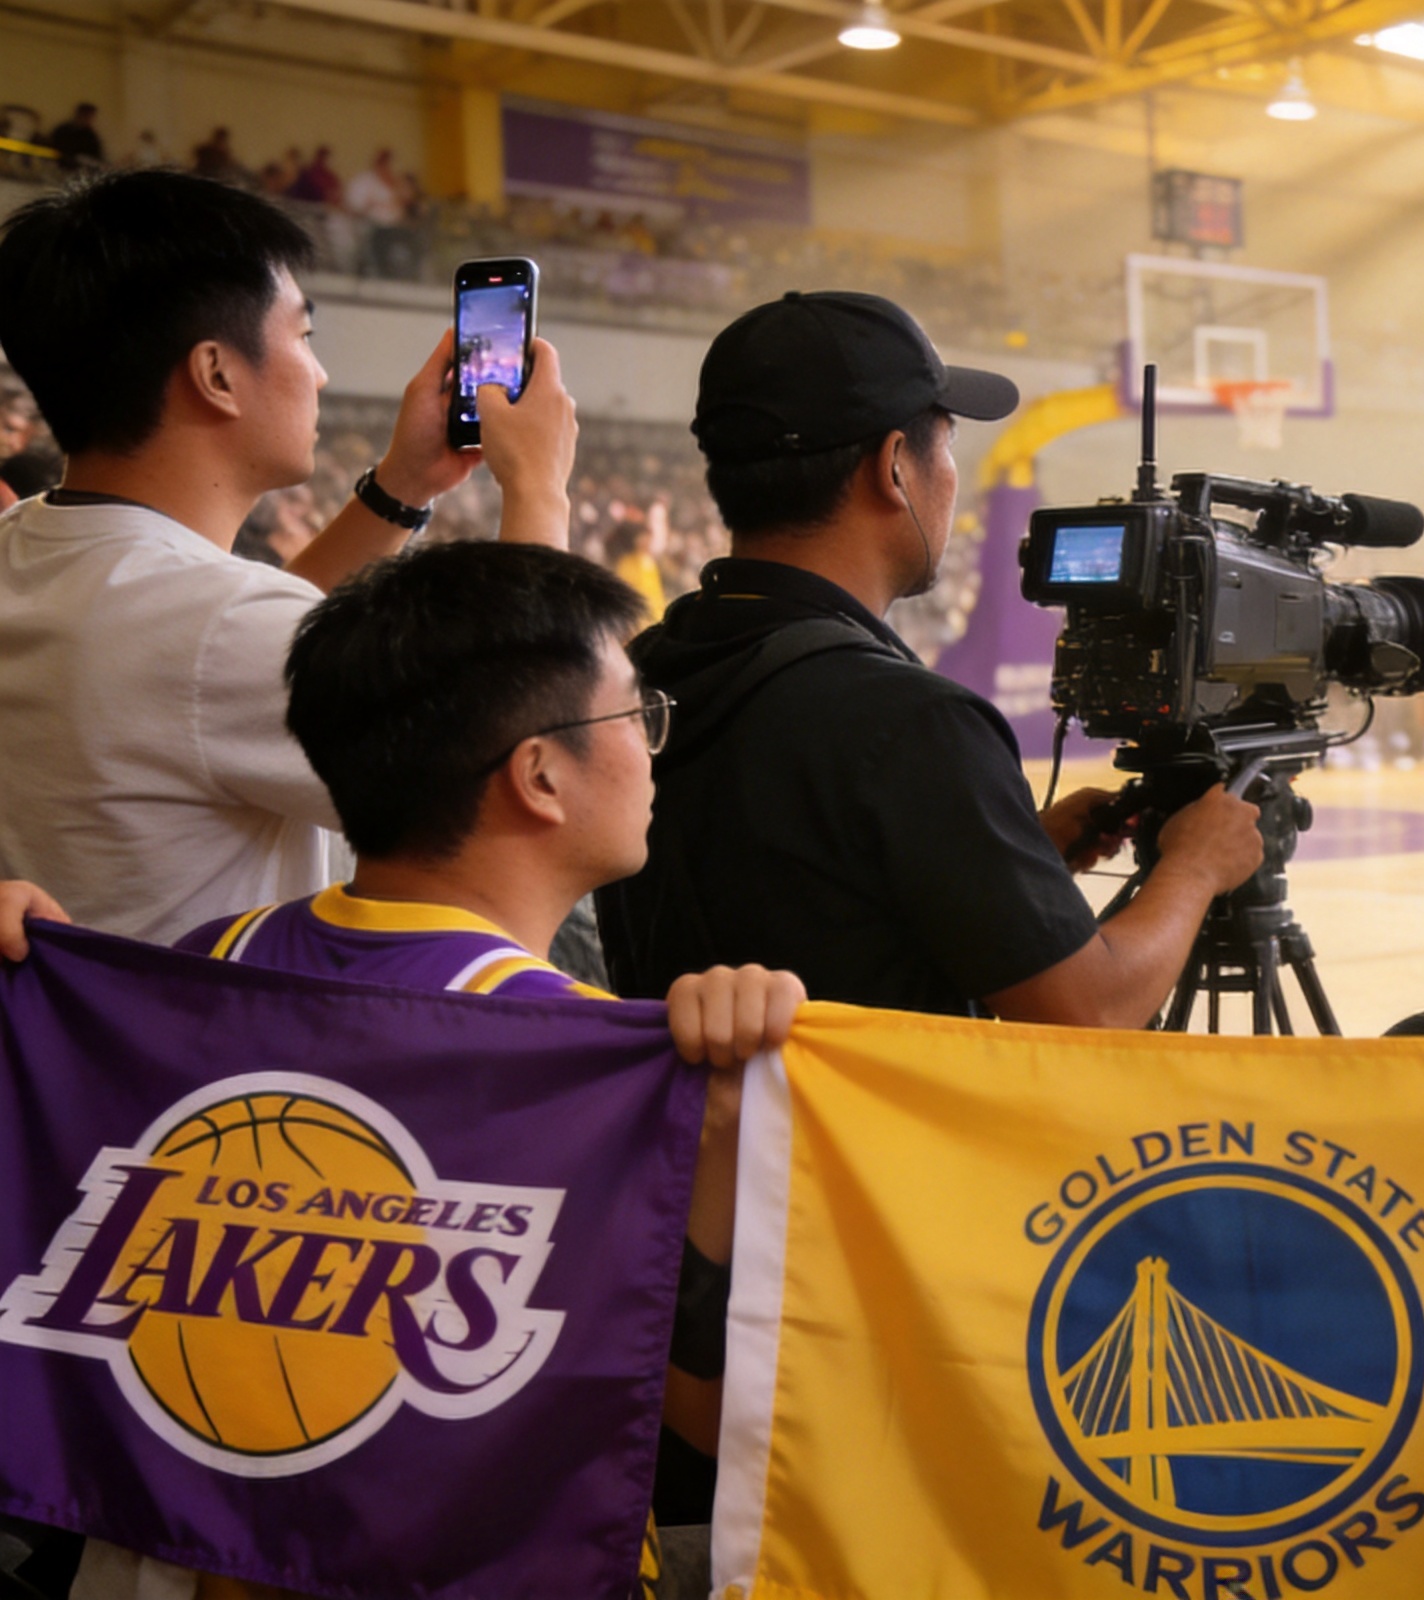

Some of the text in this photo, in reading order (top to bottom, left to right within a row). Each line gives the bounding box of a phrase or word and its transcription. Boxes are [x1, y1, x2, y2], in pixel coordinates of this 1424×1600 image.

[195, 1176, 533, 1236] LOS ANGELES
[1024, 1121, 1255, 1245] GOLDEN
[23, 1165, 535, 1394] LAKERS
